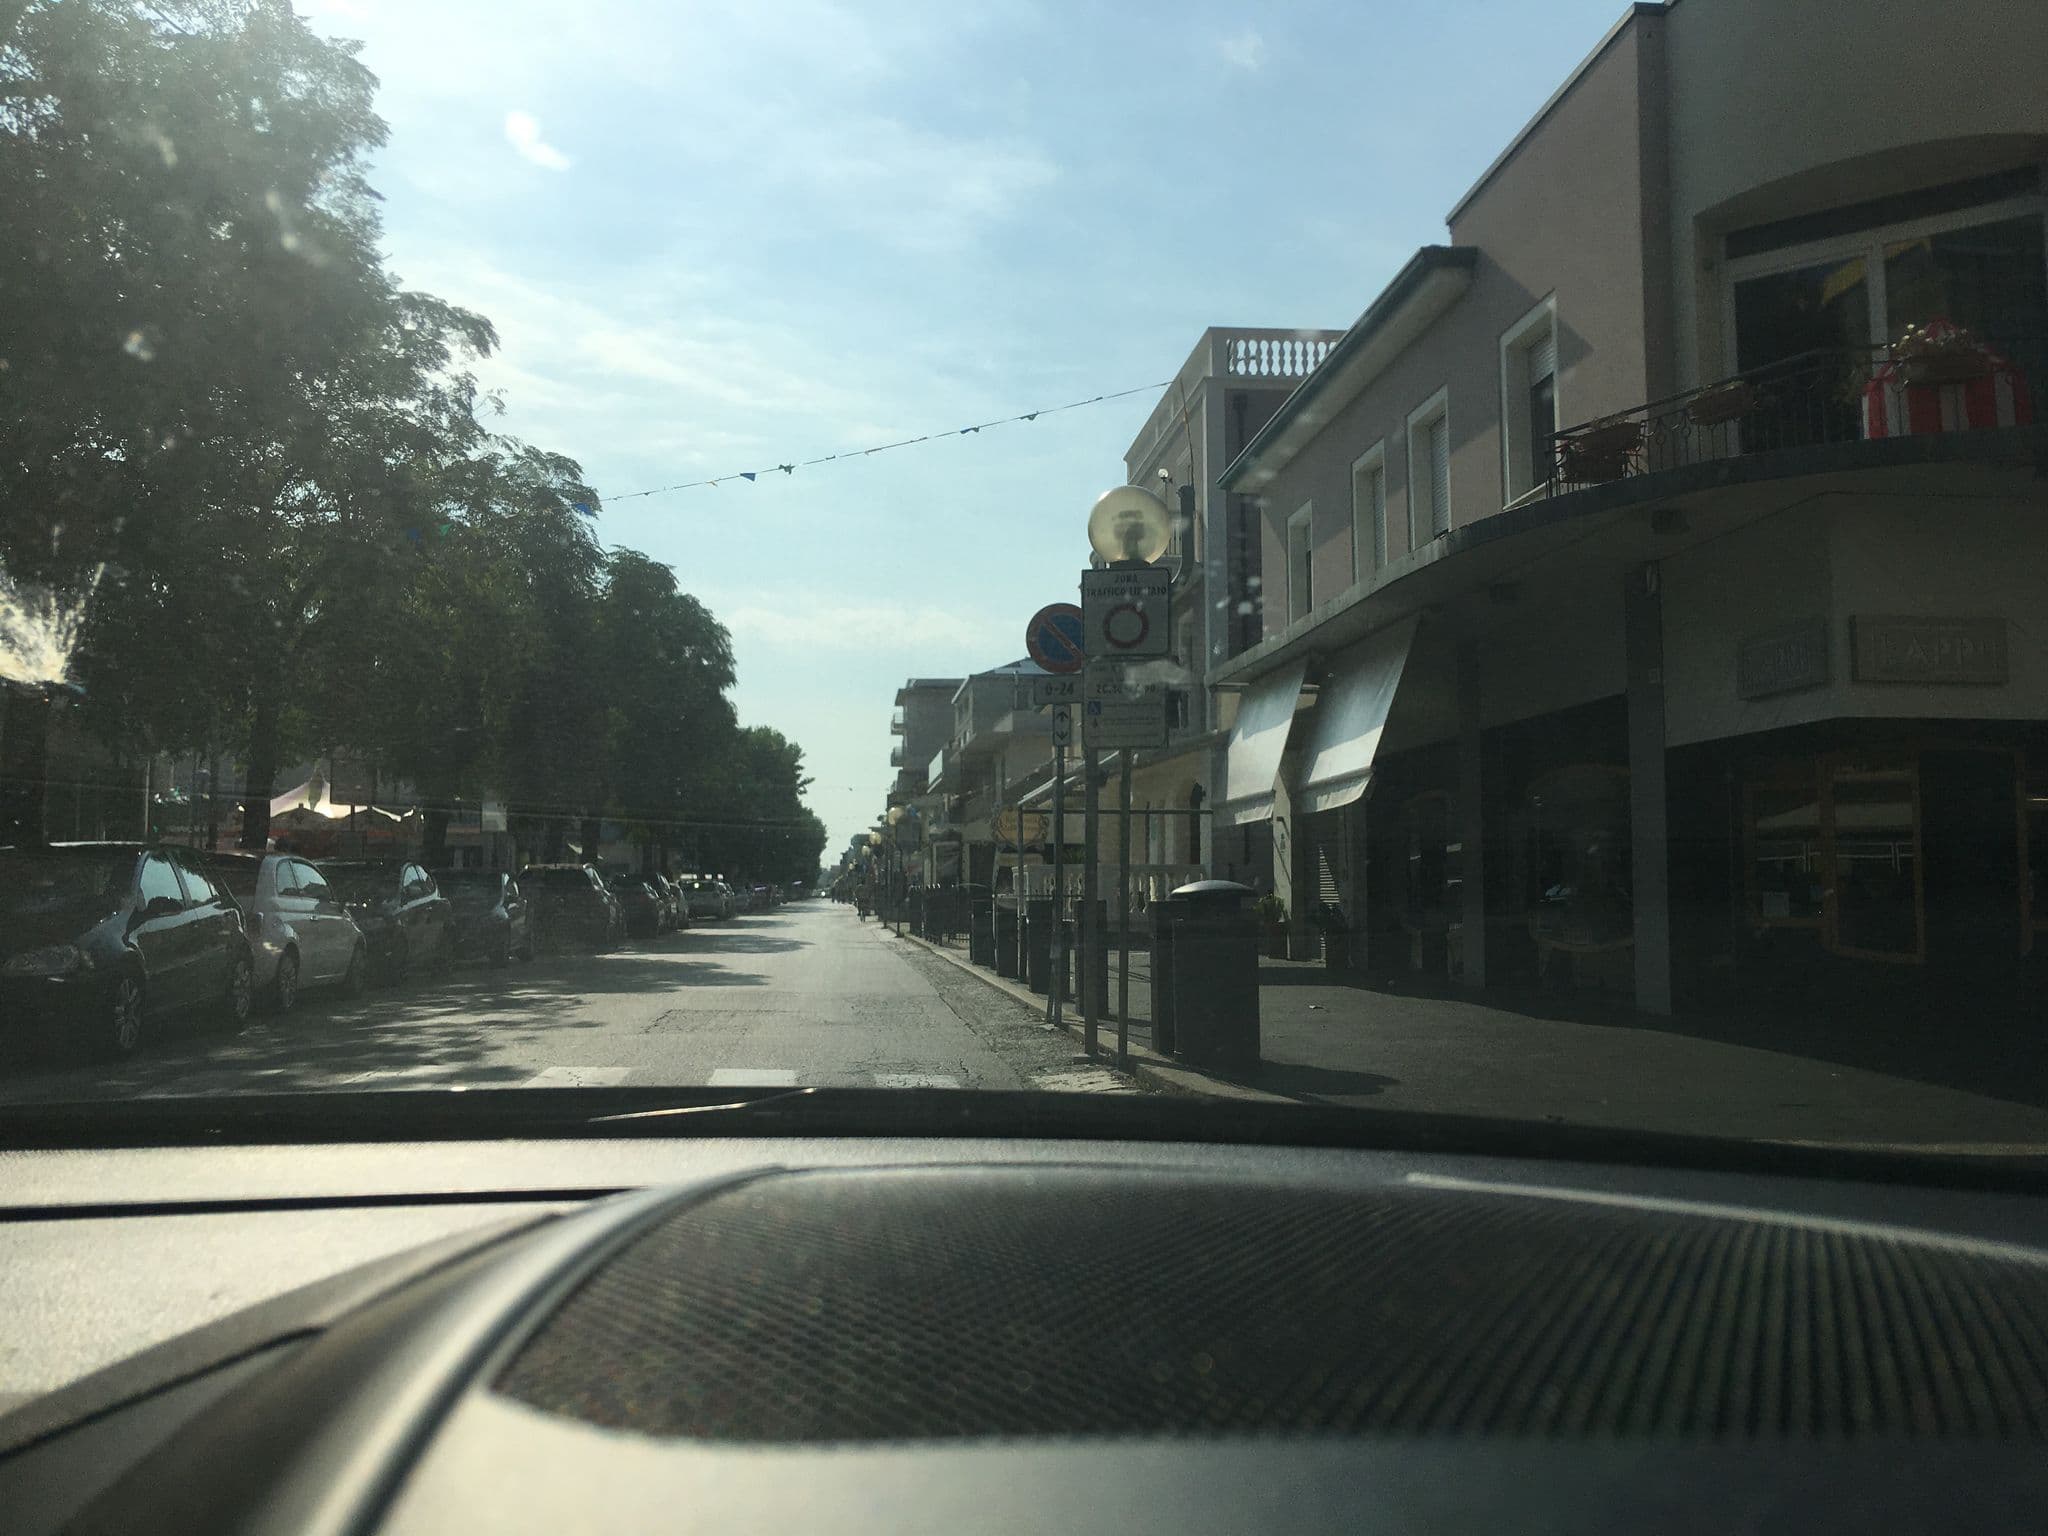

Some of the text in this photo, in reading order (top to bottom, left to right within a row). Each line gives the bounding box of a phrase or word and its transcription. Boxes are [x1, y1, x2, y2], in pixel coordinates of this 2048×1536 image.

[1114, 573, 1138, 583] ZONA
[1086, 586, 1126, 598] TRAFFICO
[1045, 682, 1074, 696] 0-24
